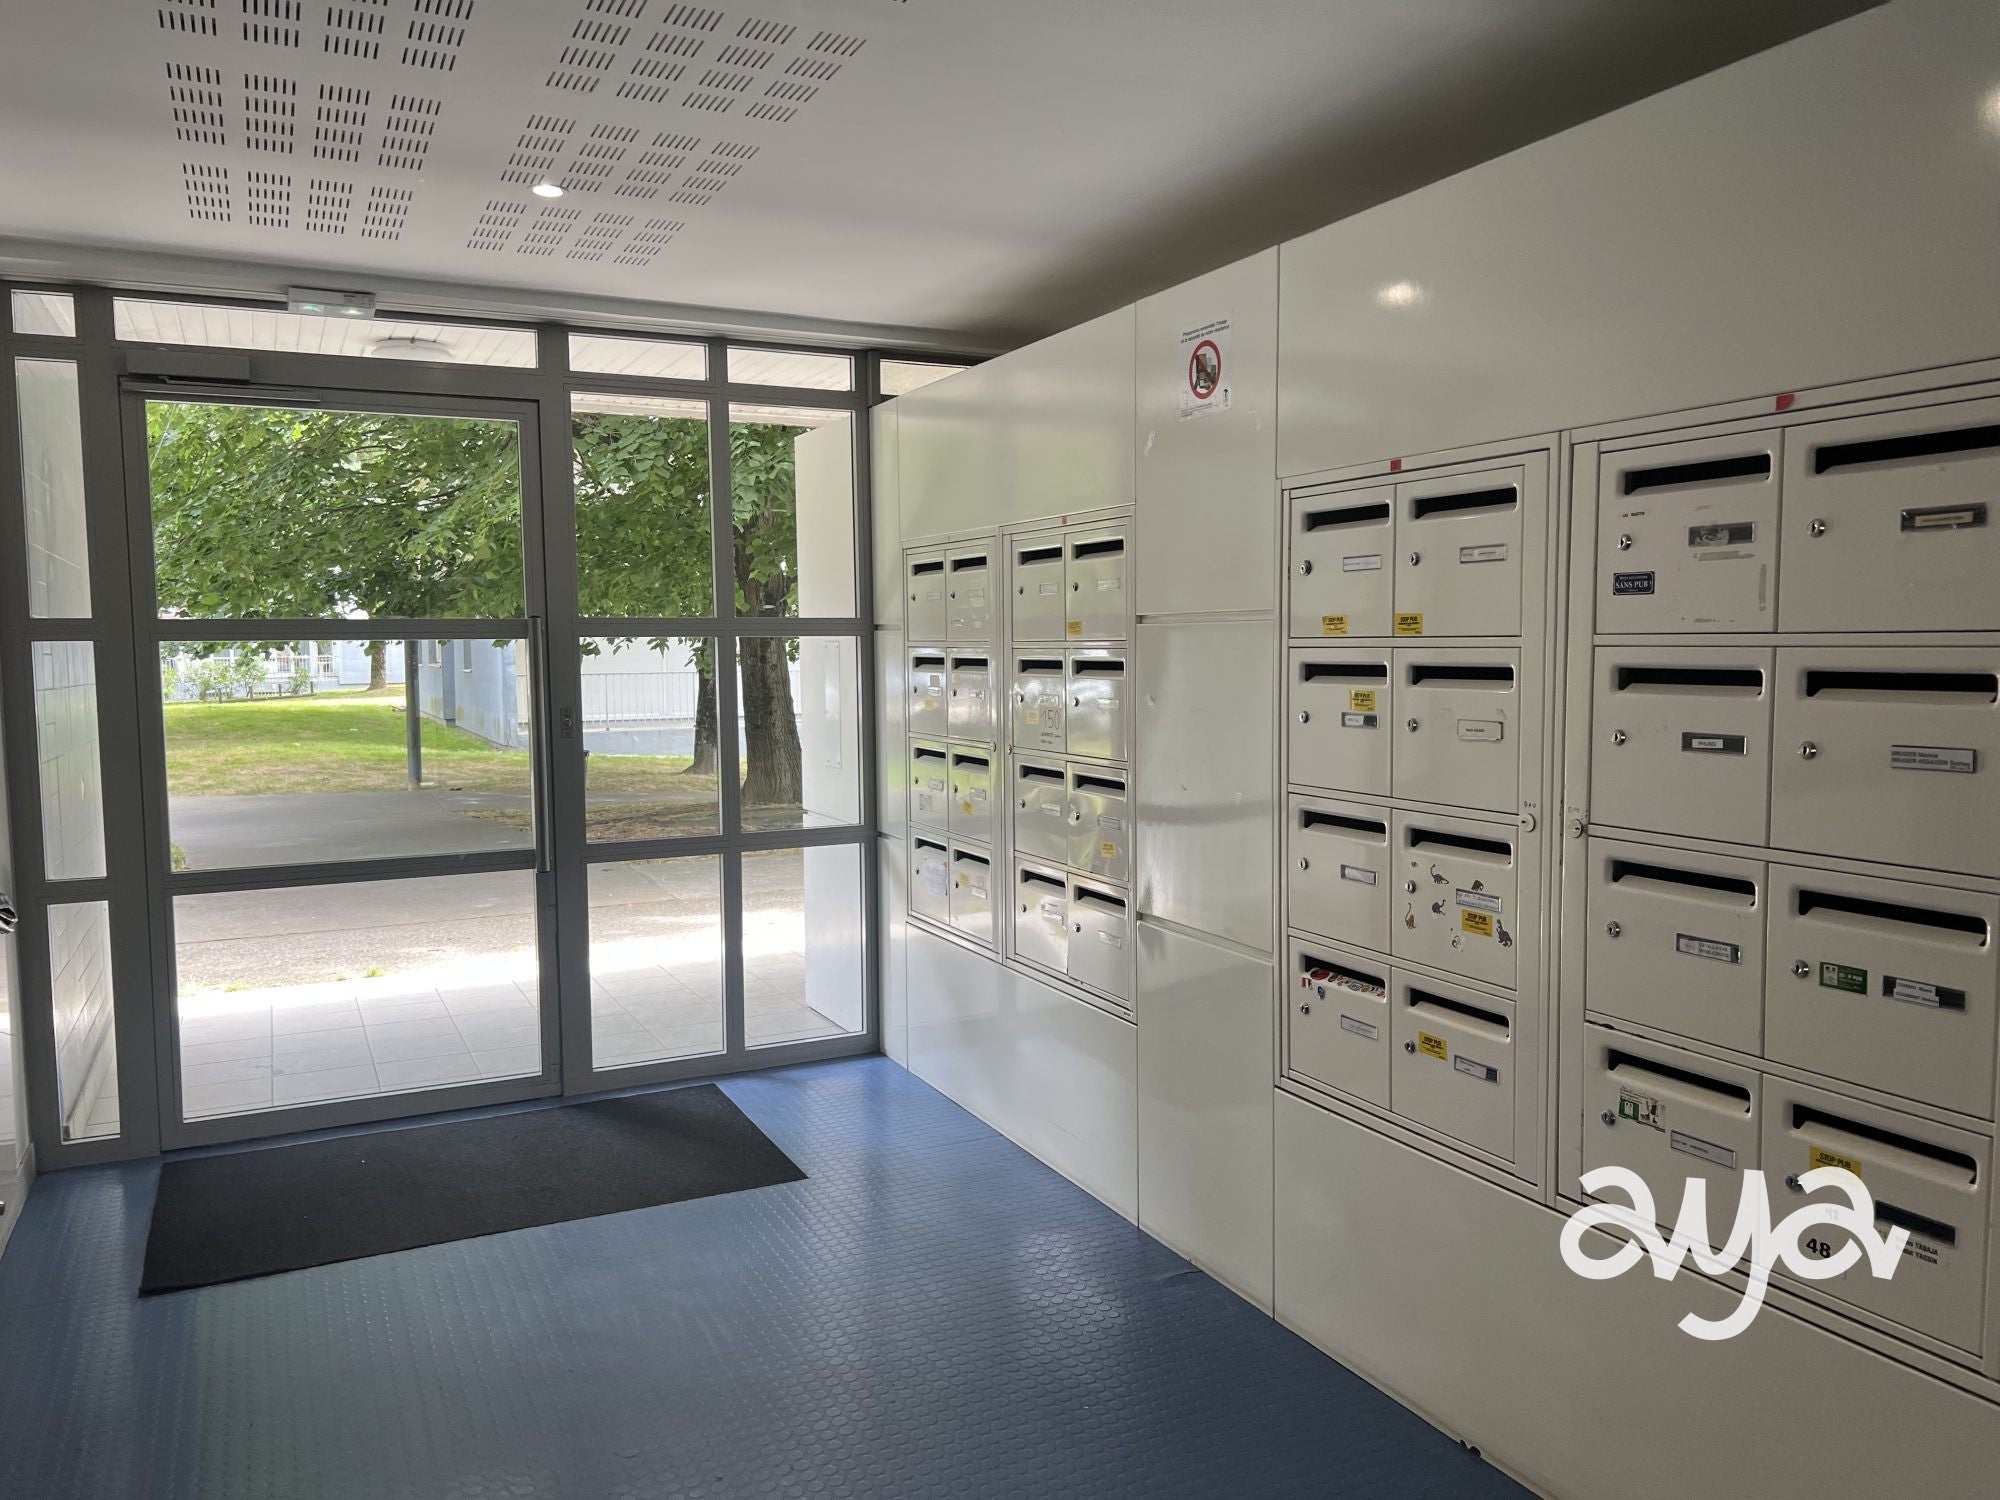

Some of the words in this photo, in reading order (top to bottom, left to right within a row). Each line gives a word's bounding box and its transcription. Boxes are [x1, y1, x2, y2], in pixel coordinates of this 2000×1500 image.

[1615, 581, 1634, 589] SANS
[1634, 580, 1649, 588] PUB
[1819, 1152, 1837, 1164] STOP
[1836, 1158, 1851, 1169] PUB
[1806, 1238, 1831, 1259] 48
